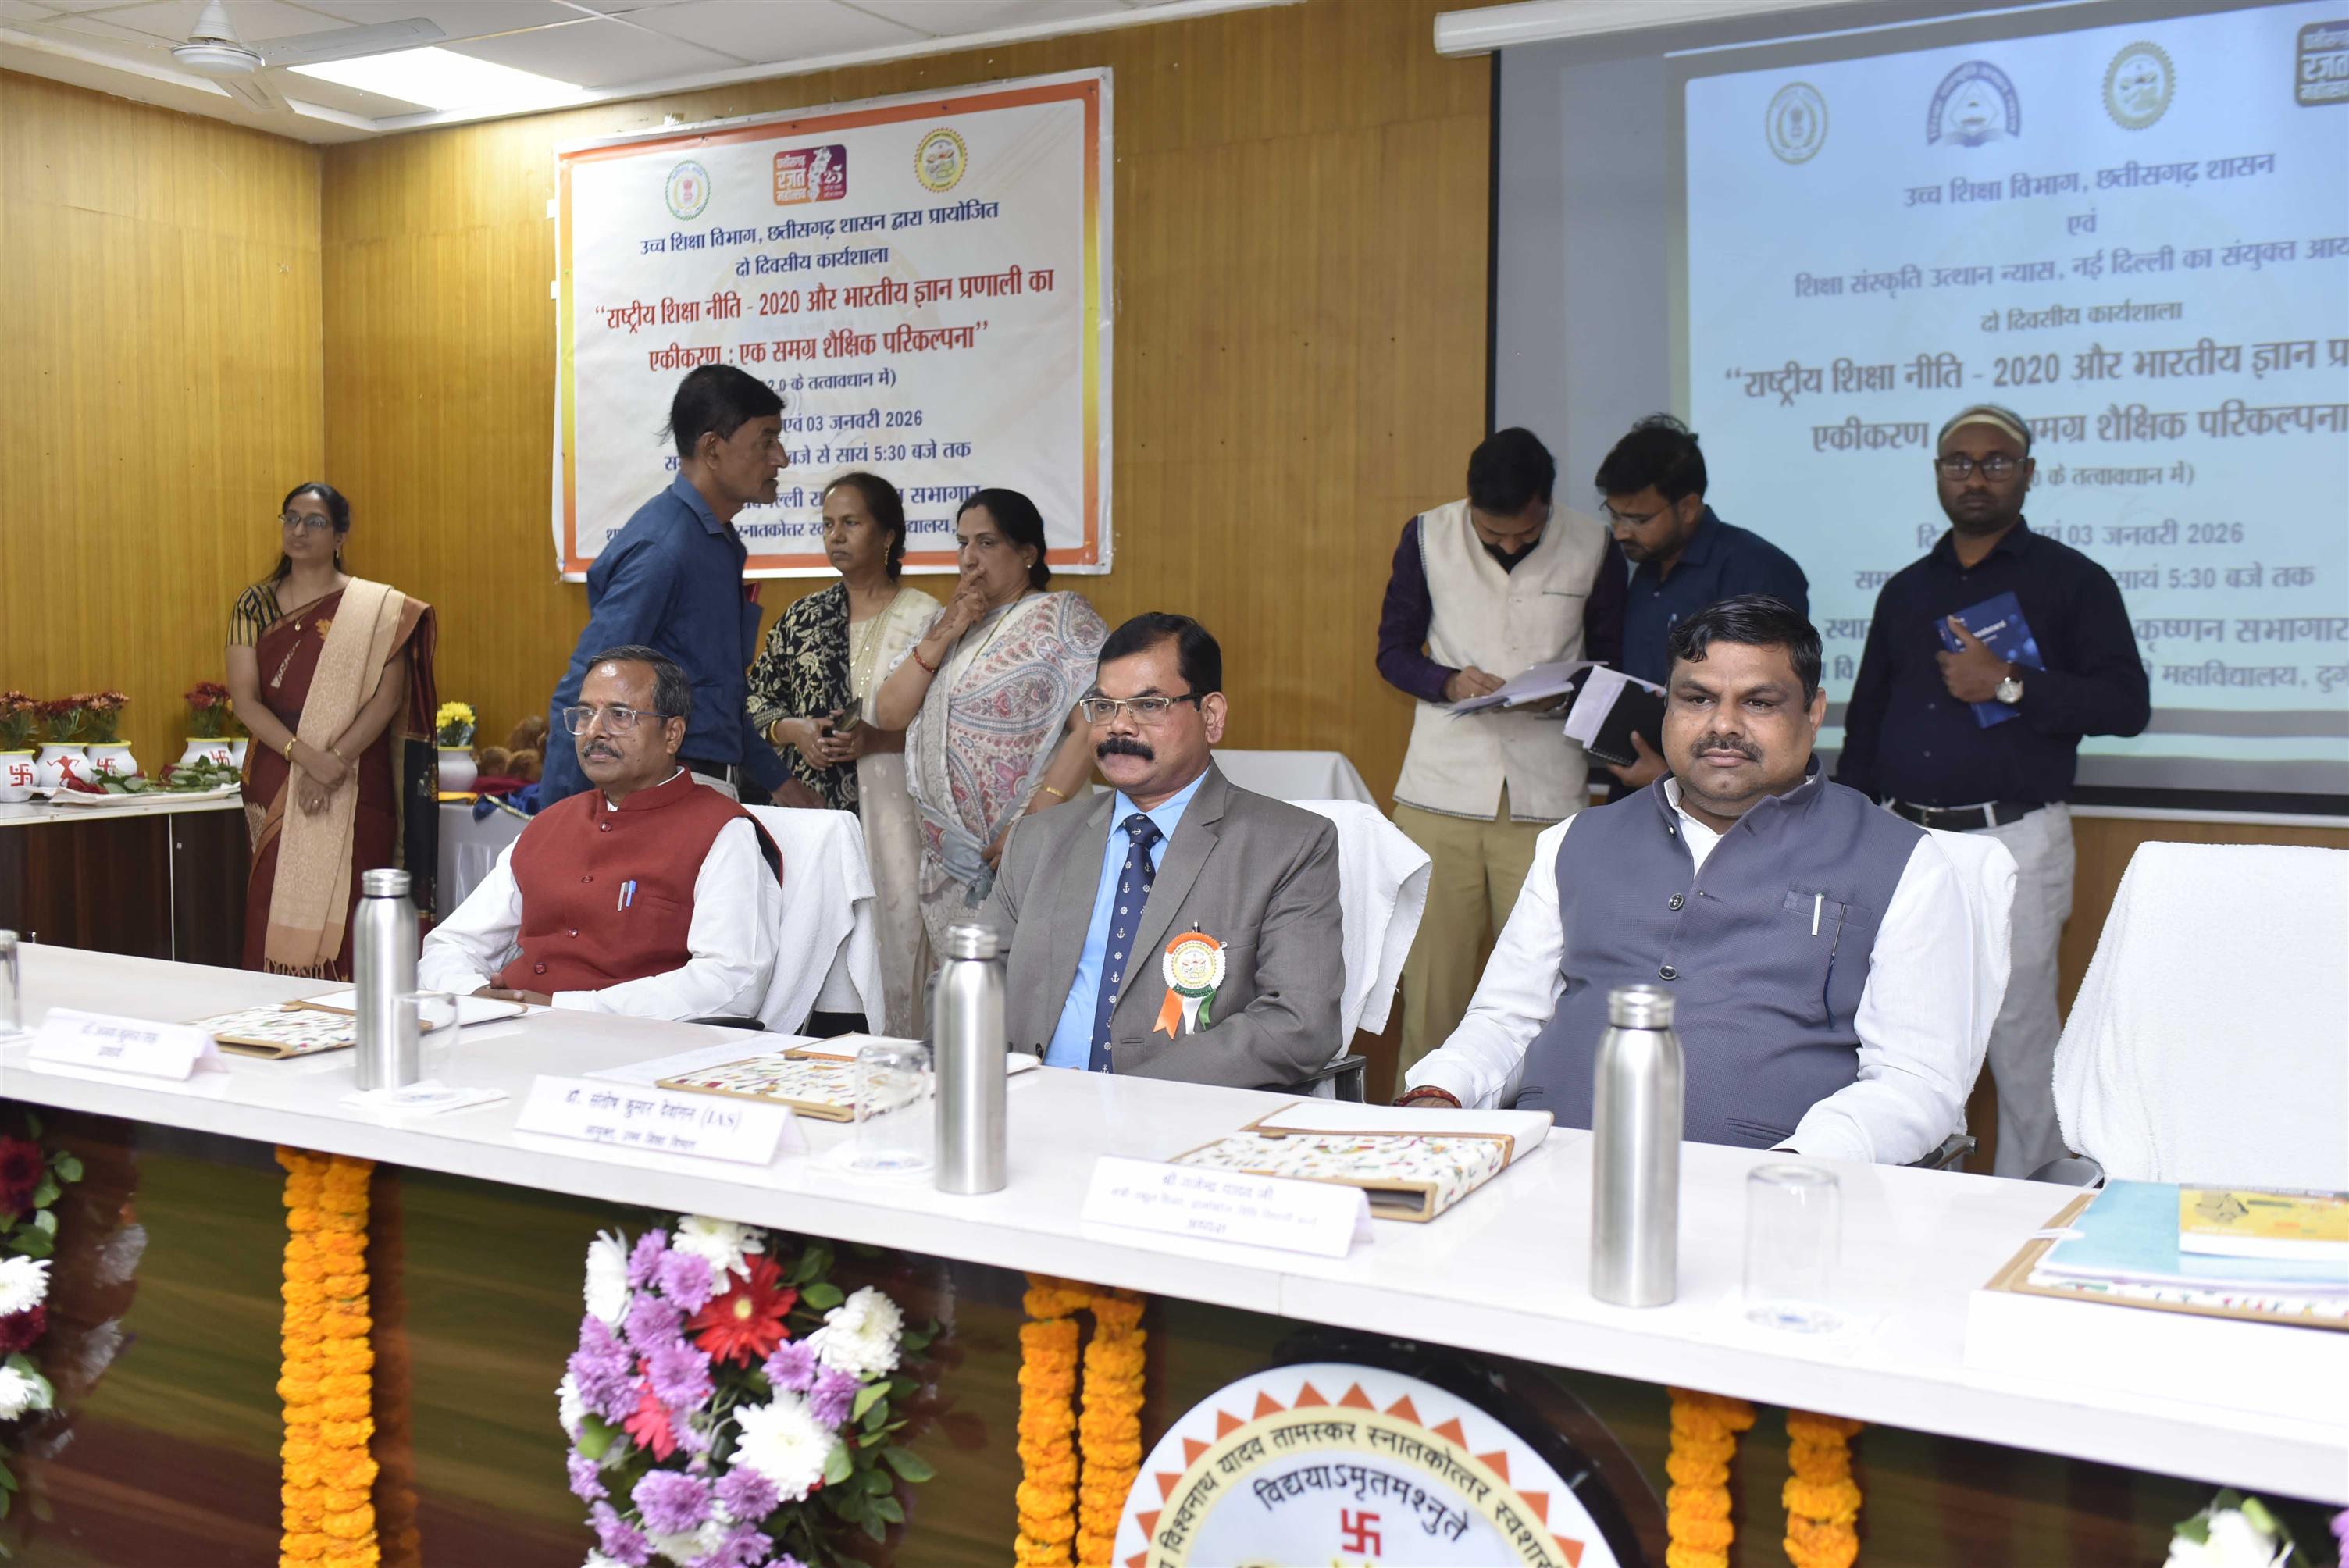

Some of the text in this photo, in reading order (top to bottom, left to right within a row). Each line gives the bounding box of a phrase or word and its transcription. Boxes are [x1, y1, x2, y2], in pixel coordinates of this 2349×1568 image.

[1904, 153, 2276, 208] उच्च शिक्षा विभाग, छत्तीसगढ़ शासन
[640, 198, 999, 255] उच्च शिक्षा विभाग, छत्तीसगढ़ शासन द्वारा प्रायोजित
[2067, 207, 2097, 236] एवं
[736, 245, 889, 276] दो दिवसीय कार्यशाला
[1795, 272, 1843, 298] शिक्षा
[1850, 264, 1922, 299] संस्कृति
[1930, 266, 1993, 287] उत्थान
[2073, 248, 2104, 280] नई
[2112, 244, 2174, 274] दिल्ली
[2183, 248, 2212, 269] का
[2222, 239, 2297, 271] संयुक्त
[661, 297, 700, 326] शिक्षा
[705, 290, 741, 320] नीति
[759, 290, 800, 315] 2020
[807, 282, 836, 312] और
[843, 276, 908, 308] भारतीय
[914, 279, 952, 308] ज्ञान
[959, 265, 1022, 298] प्रणाली
[1028, 269, 1054, 292] का
[1980, 299, 2183, 333] दो दिवसीय कार्यशाला
[649, 343, 721, 371] एकीकरण
[739, 343, 766, 365] एक
[772, 339, 817, 361] समग्र
[823, 328, 876, 358] शैक्षिक
[1832, 357, 1895, 392] शिक्षा
[1904, 352, 1962, 389] नीति
[1993, 353, 2060, 387] 2020
[2072, 343, 2123, 381] और
[2133, 337, 2241, 378] भारतीय
[2252, 340, 2316, 380] ज्ञान
[791, 373, 804, 391] के
[808, 372, 873, 390] तत्वावधान
[878, 368, 896, 388] में)
[783, 408, 922, 433] एवं 03 जनवरी 2026
[1812, 416, 1929, 452] एकीकरण
[2098, 404, 2187, 443] शैक्षिक
[816, 444, 830, 464] से
[836, 442, 868, 463] सायं
[875, 444, 906, 461] 5:30
[911, 439, 937, 459] बजे
[943, 441, 971, 458] तक
[2048, 463, 2066, 486] के
[2068, 525, 2093, 545] 03
[2102, 519, 2178, 546] जनवरी
[2187, 522, 2244, 544] 2026
[2169, 567, 2215, 590] 5:30
[2225, 561, 2263, 589] बजे
[2272, 565, 2316, 587] तक
[1159, 1470, 1219, 1554] विश्वनाथ
[1217, 1437, 1267, 1474] यादव
[1271, 1422, 1356, 1448] तामस्कर
[1367, 1425, 1491, 1502] स्नातकोत्तर
